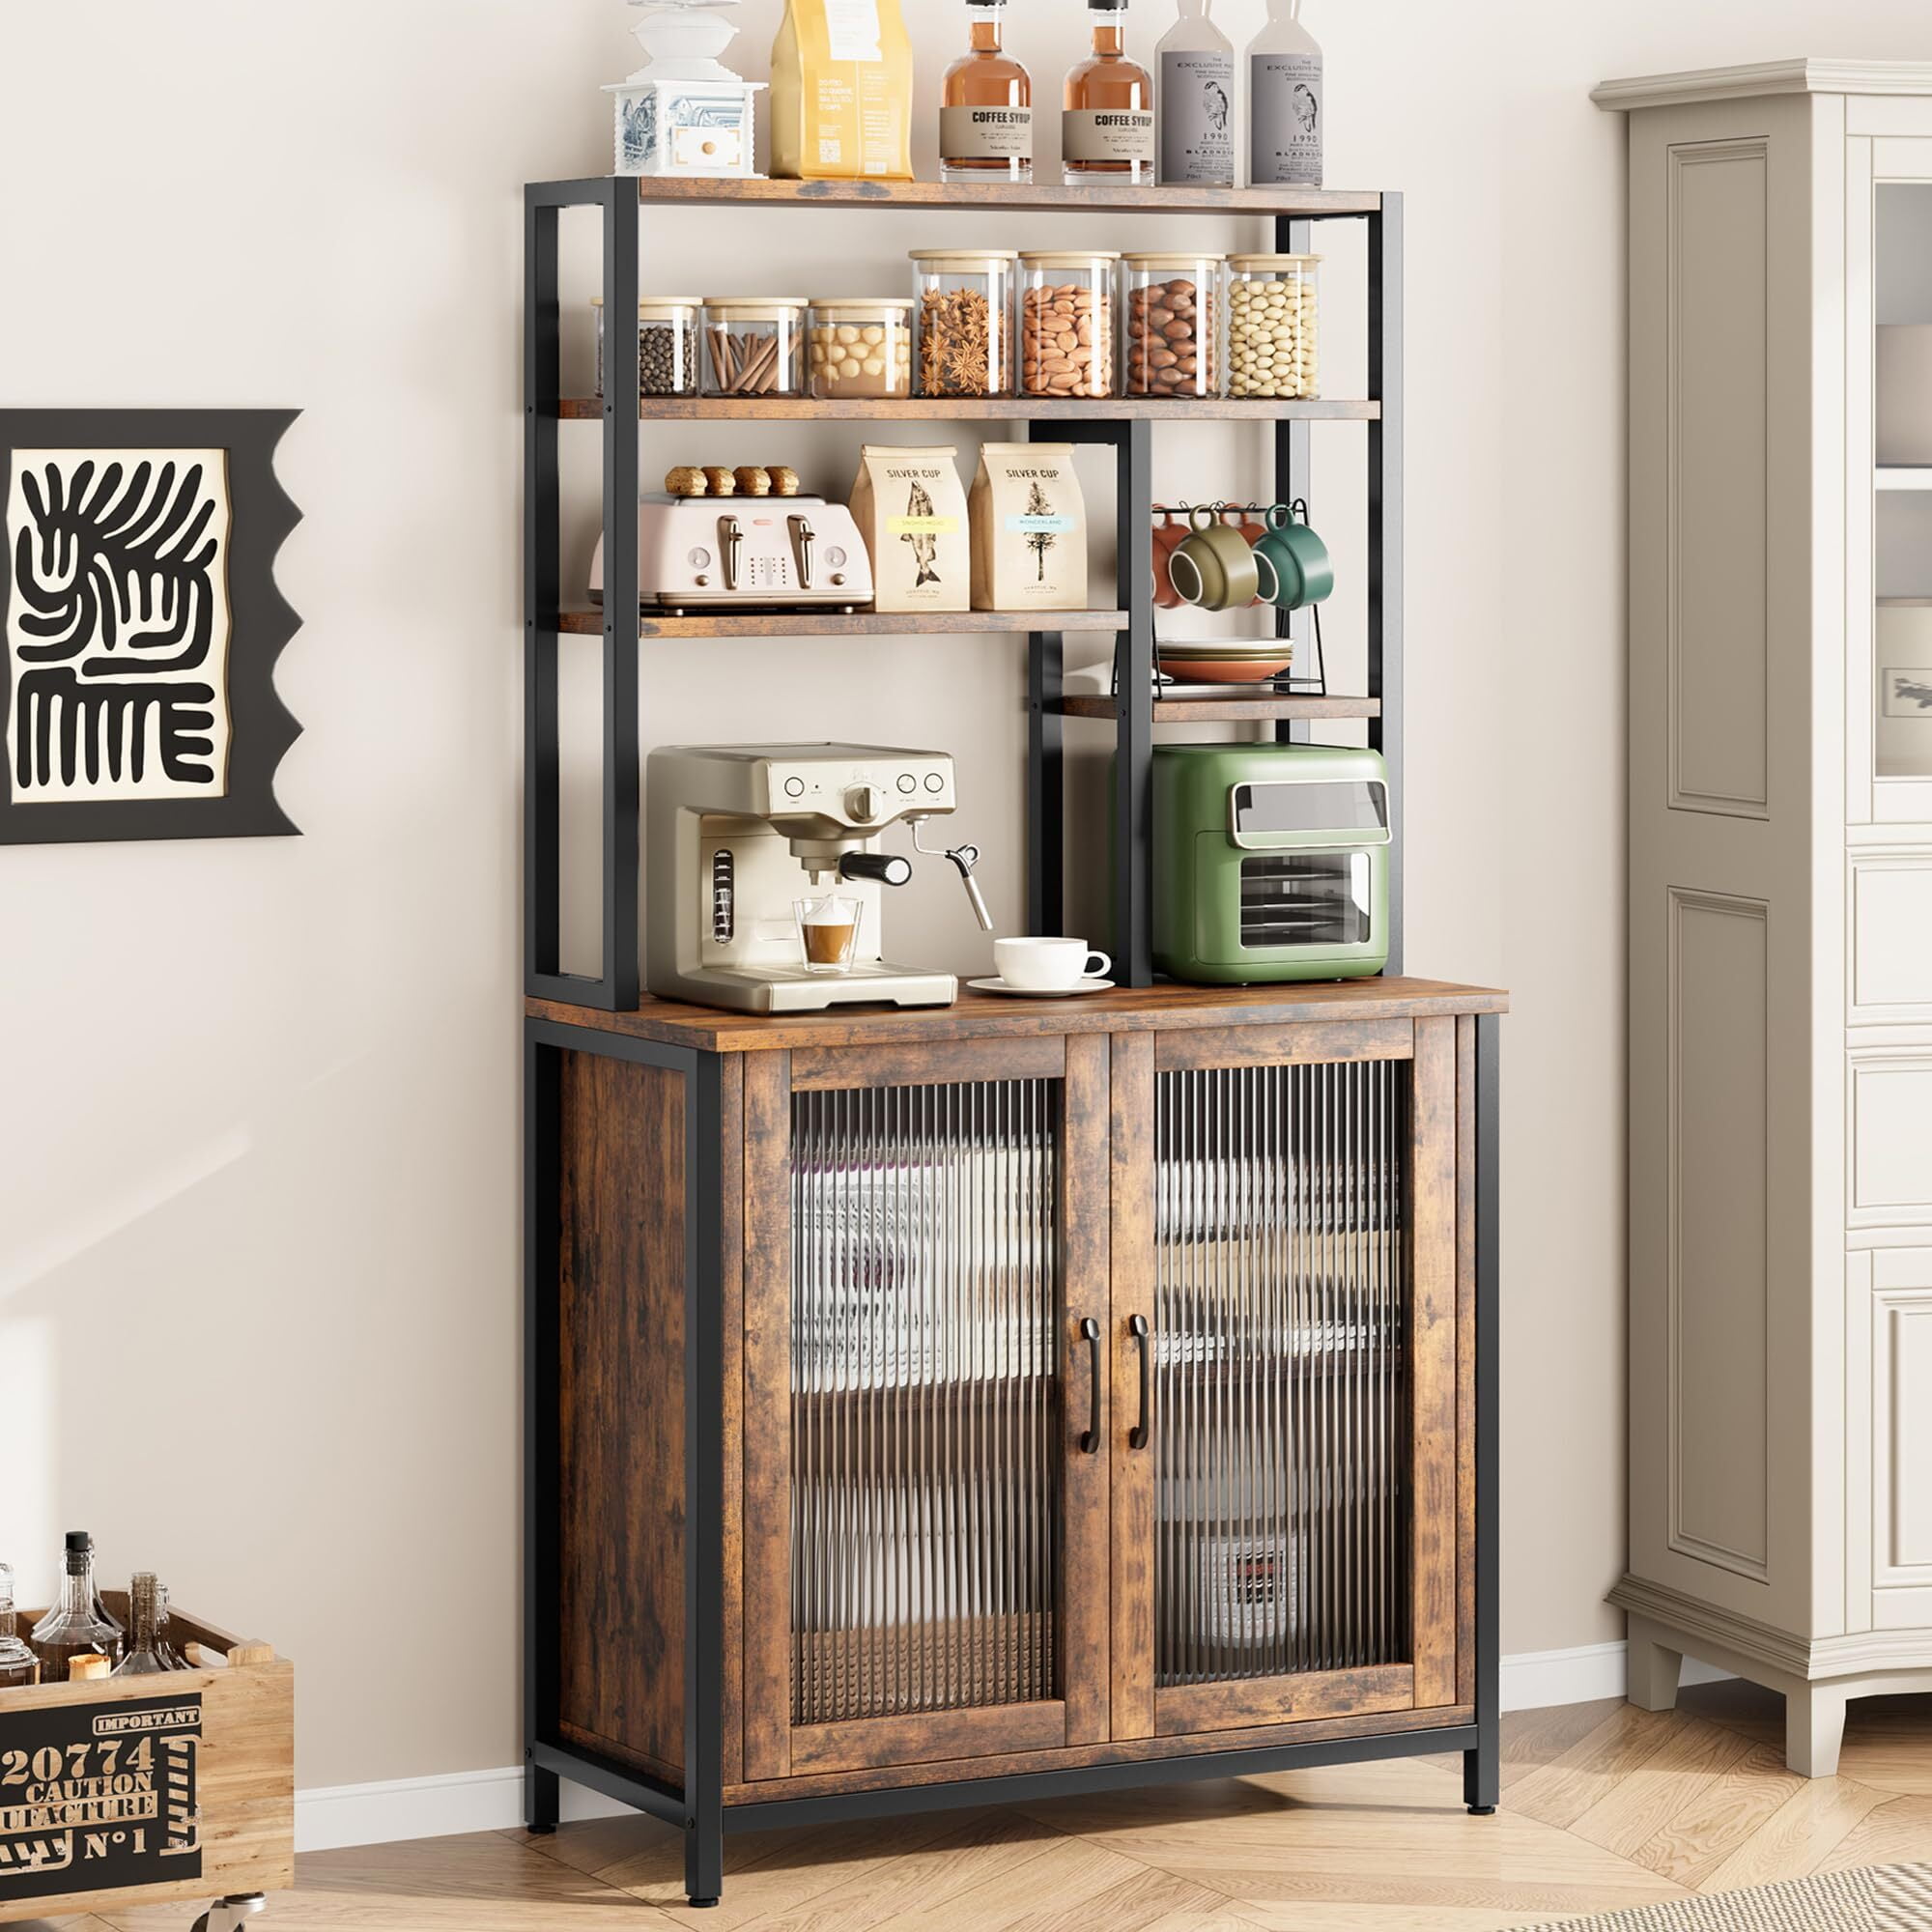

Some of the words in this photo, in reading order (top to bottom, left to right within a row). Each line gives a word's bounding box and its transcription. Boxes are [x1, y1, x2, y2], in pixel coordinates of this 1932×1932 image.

[972, 111, 1008, 123] COFFEE
[1009, 112, 1031, 124] SYRUP
[1094, 114, 1130, 126] COFFEE
[1131, 115, 1152, 127] SYRUP
[1204, 132, 1228, 141] 1990
[1293, 134, 1318, 143] 1990
[886, 469, 920, 479] SILVER
[921, 469, 942, 479] CUP
[1005, 469, 1037, 479] SILVER
[1038, 469, 1060, 478] CUP
[98, 1709, 198, 1732] IMPORTANT
[1, 1737, 156, 1786] 20774
[25, 1771, 154, 1804] CAUTION
